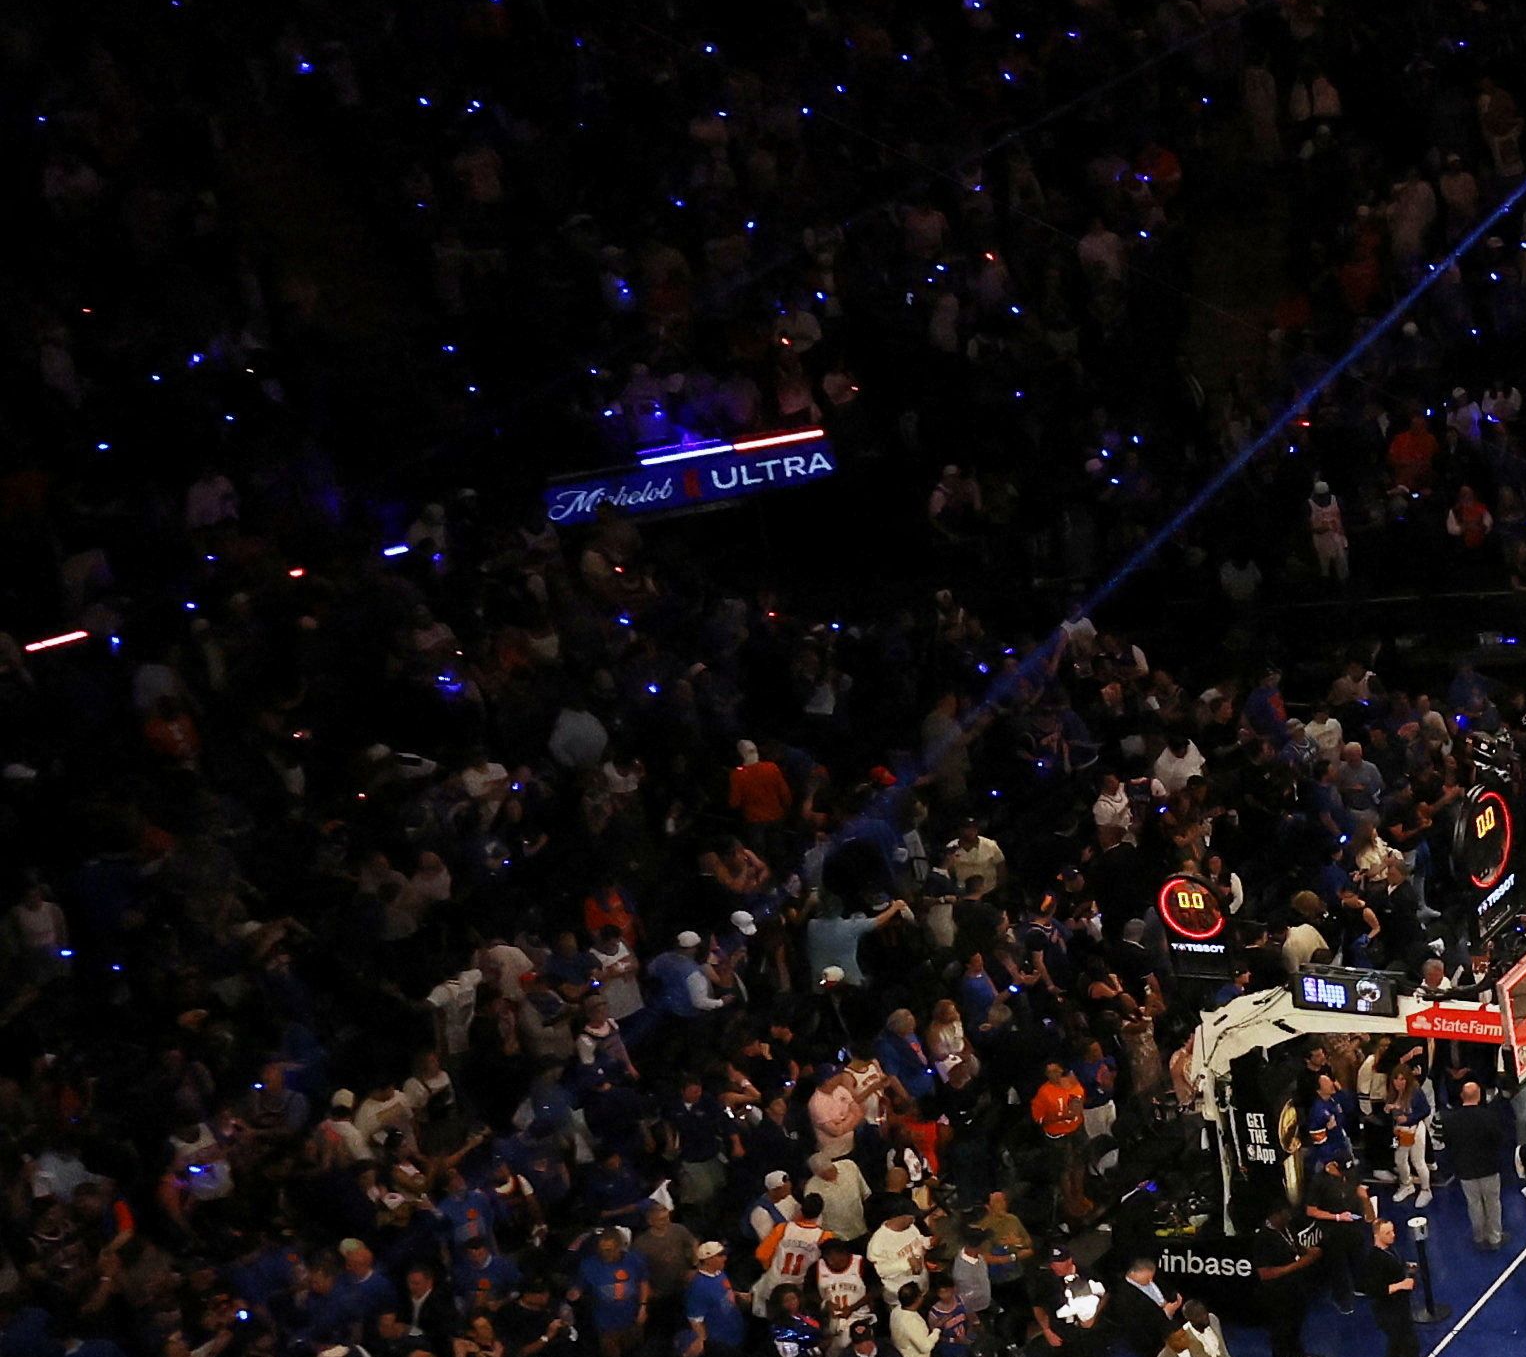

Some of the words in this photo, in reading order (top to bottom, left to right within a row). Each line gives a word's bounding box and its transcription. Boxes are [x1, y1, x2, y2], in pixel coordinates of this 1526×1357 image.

[711, 452, 833, 490] ULTRA
[1476, 806, 1496, 839] 0.0
[1178, 891, 1205, 909] 0.0
[1183, 943, 1226, 954] TISSOT
[1317, 979, 1346, 1009] App
[1245, 1112, 1266, 1129] GET
[1248, 1129, 1269, 1145] THE
[1256, 1145, 1277, 1164] App
[783, 1252, 805, 1276] 11
[1159, 1248, 1252, 1277] inbase
